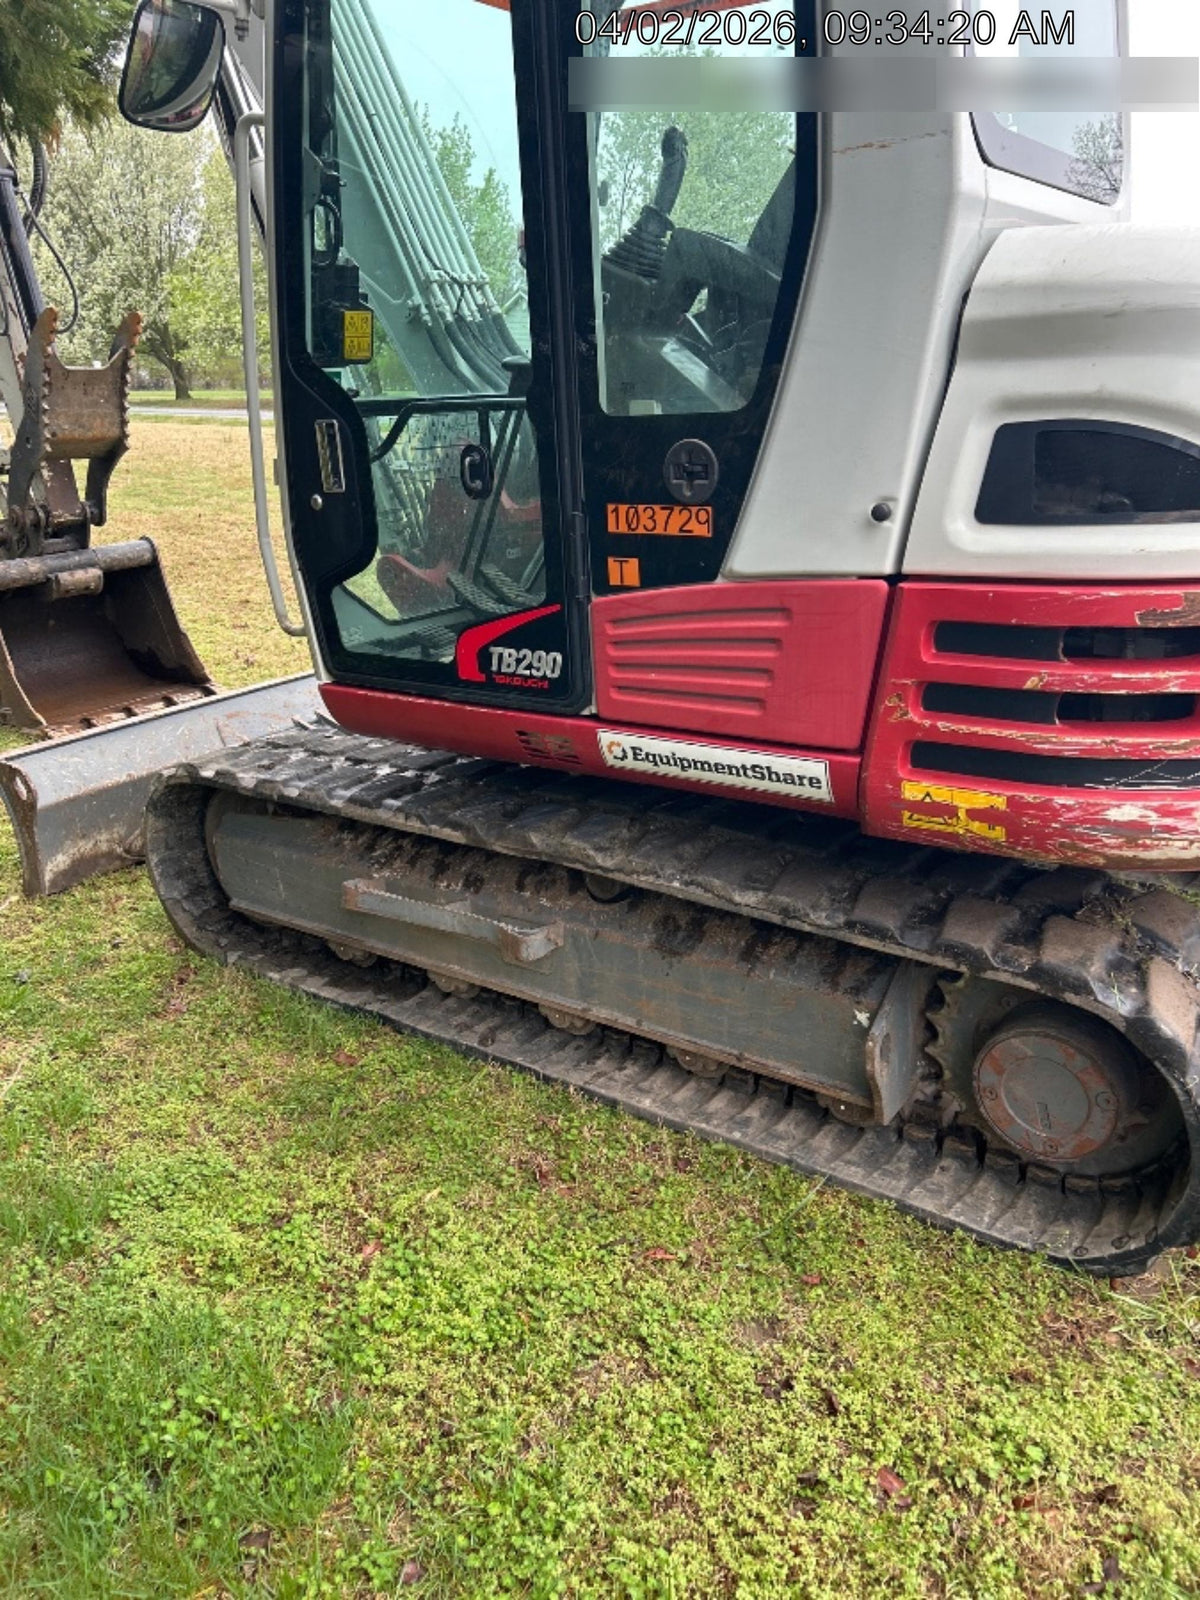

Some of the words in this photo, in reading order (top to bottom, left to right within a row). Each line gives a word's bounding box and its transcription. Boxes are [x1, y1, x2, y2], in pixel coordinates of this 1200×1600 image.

[611, 507, 711, 534] 103729
[613, 560, 630, 583] T
[489, 647, 562, 678] TB290
[631, 747, 822, 789] EquipmentShare
